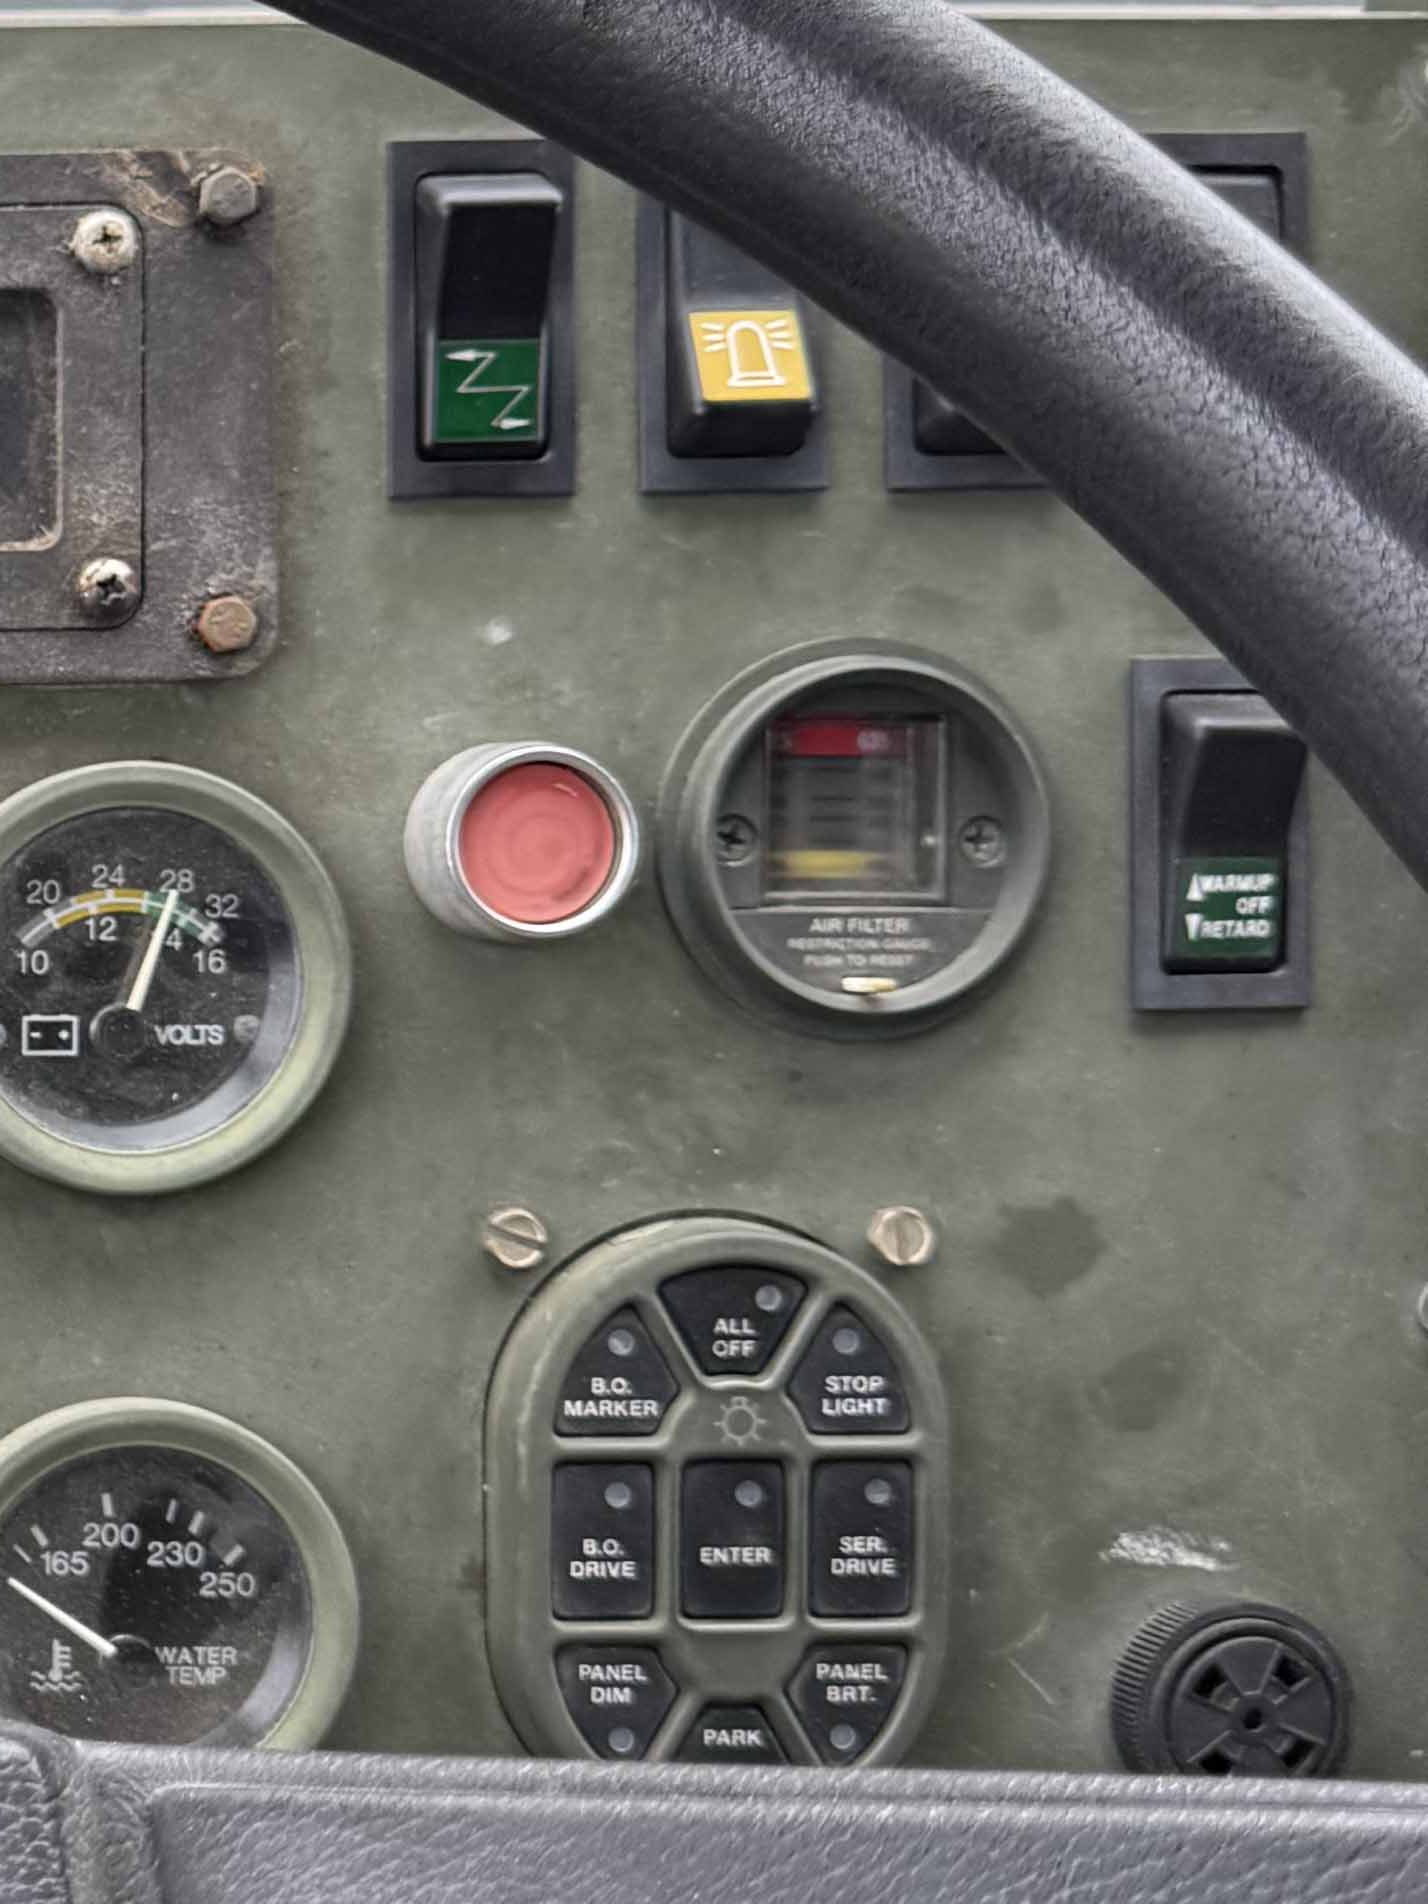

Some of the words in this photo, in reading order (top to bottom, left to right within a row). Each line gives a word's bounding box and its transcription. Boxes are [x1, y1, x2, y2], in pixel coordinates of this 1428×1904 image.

[90, 864, 126, 887] 24
[158, 869, 195, 892] 28
[1201, 873, 1276, 893] WARMUP
[26, 879, 61, 904] 20
[204, 894, 240, 918] 32
[1235, 895, 1273, 915] OFF
[85, 916, 117, 941] 12
[808, 917, 843, 934] AIR
[847, 917, 910, 934] FILTER
[1201, 918, 1271, 938] RETARD
[16, 950, 50, 974] 10
[192, 949, 226, 973] 16
[845, 953, 867, 967] TO
[154, 1023, 225, 1047] VOLTS
[713, 1318, 756, 1336] ALL
[712, 1339, 756, 1359] OFF
[590, 1376, 633, 1395] B.O.
[824, 1375, 884, 1395] STOP
[563, 1399, 659, 1420] MARKER
[821, 1397, 888, 1418] LIGHT
[82, 1521, 140, 1549] 200
[147, 1541, 205, 1568] 230
[582, 1538, 625, 1557] B.O.
[838, 1536, 888, 1556] SER.
[41, 1550, 89, 1576] 165
[699, 1546, 773, 1567] ENTER
[569, 1559, 637, 1580] DRIVE
[830, 1557, 897, 1577] DRIVE
[199, 1572, 256, 1598] 250
[155, 1645, 238, 1665] WATER
[166, 1666, 227, 1685] TEMP
[578, 1664, 648, 1684] PANEL
[815, 1663, 888, 1682] PANEL
[589, 1686, 633, 1705] DIM
[825, 1685, 877, 1704] BRT.
[702, 1728, 763, 1747] PARK
